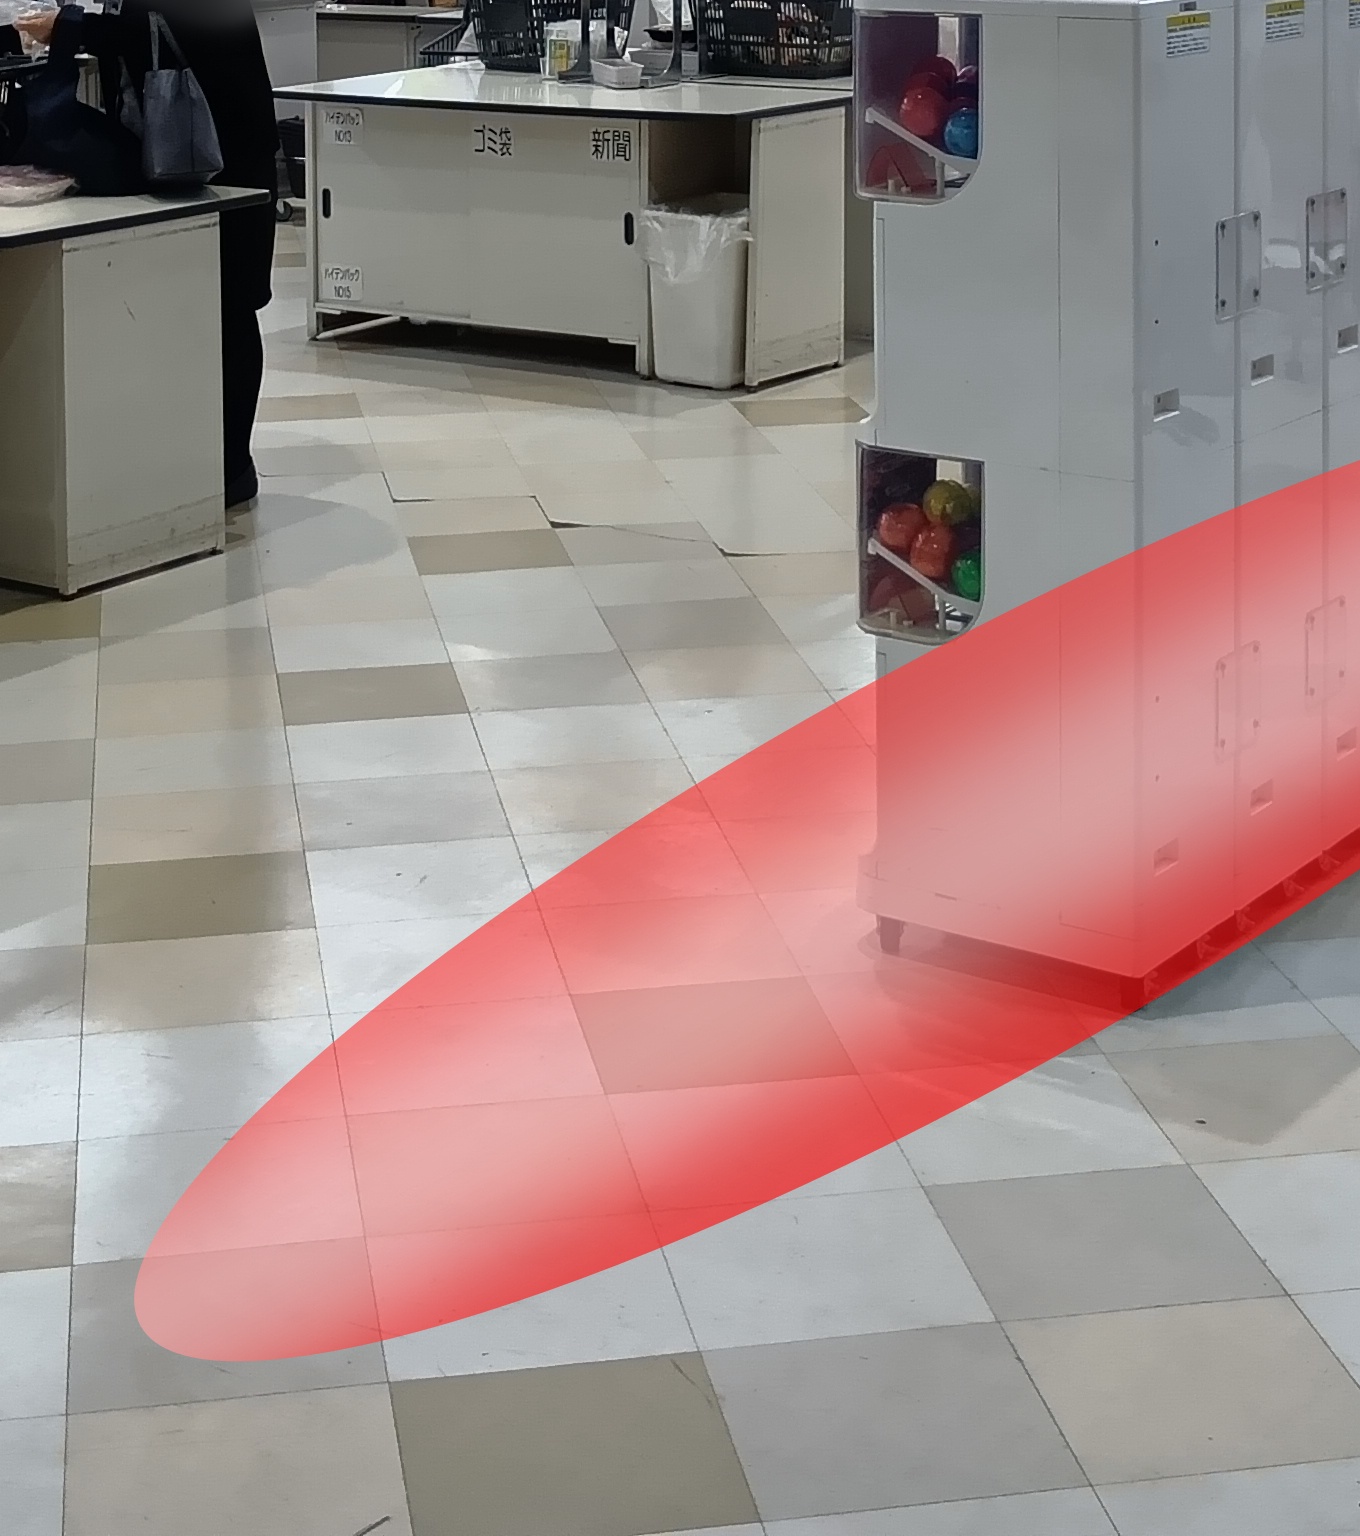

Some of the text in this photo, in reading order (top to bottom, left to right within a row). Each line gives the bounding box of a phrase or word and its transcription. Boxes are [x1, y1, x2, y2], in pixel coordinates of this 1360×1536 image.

[473, 124, 514, 158] ゴミ袋
[591, 127, 632, 163] 新聞
